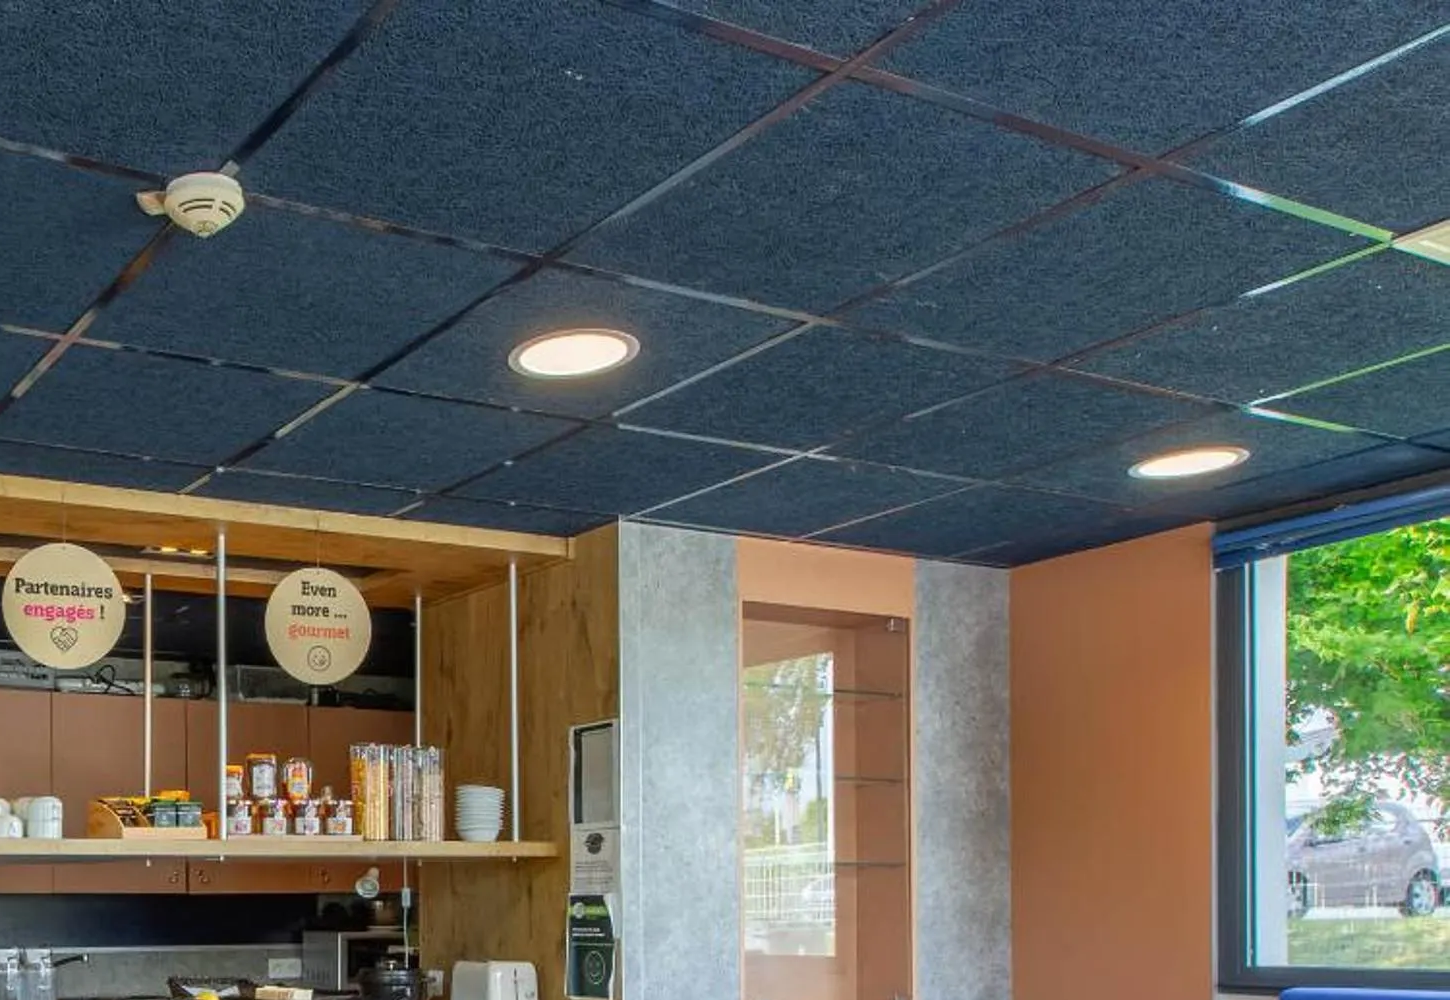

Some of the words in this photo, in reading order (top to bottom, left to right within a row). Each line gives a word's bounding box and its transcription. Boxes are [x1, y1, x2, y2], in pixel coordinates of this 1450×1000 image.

[14, 577, 114, 599] Partenaires
[301, 581, 337, 597] Even
[24, 602, 95, 623] engagés
[291, 605, 330, 617] more
[288, 623, 349, 640] gourmet
